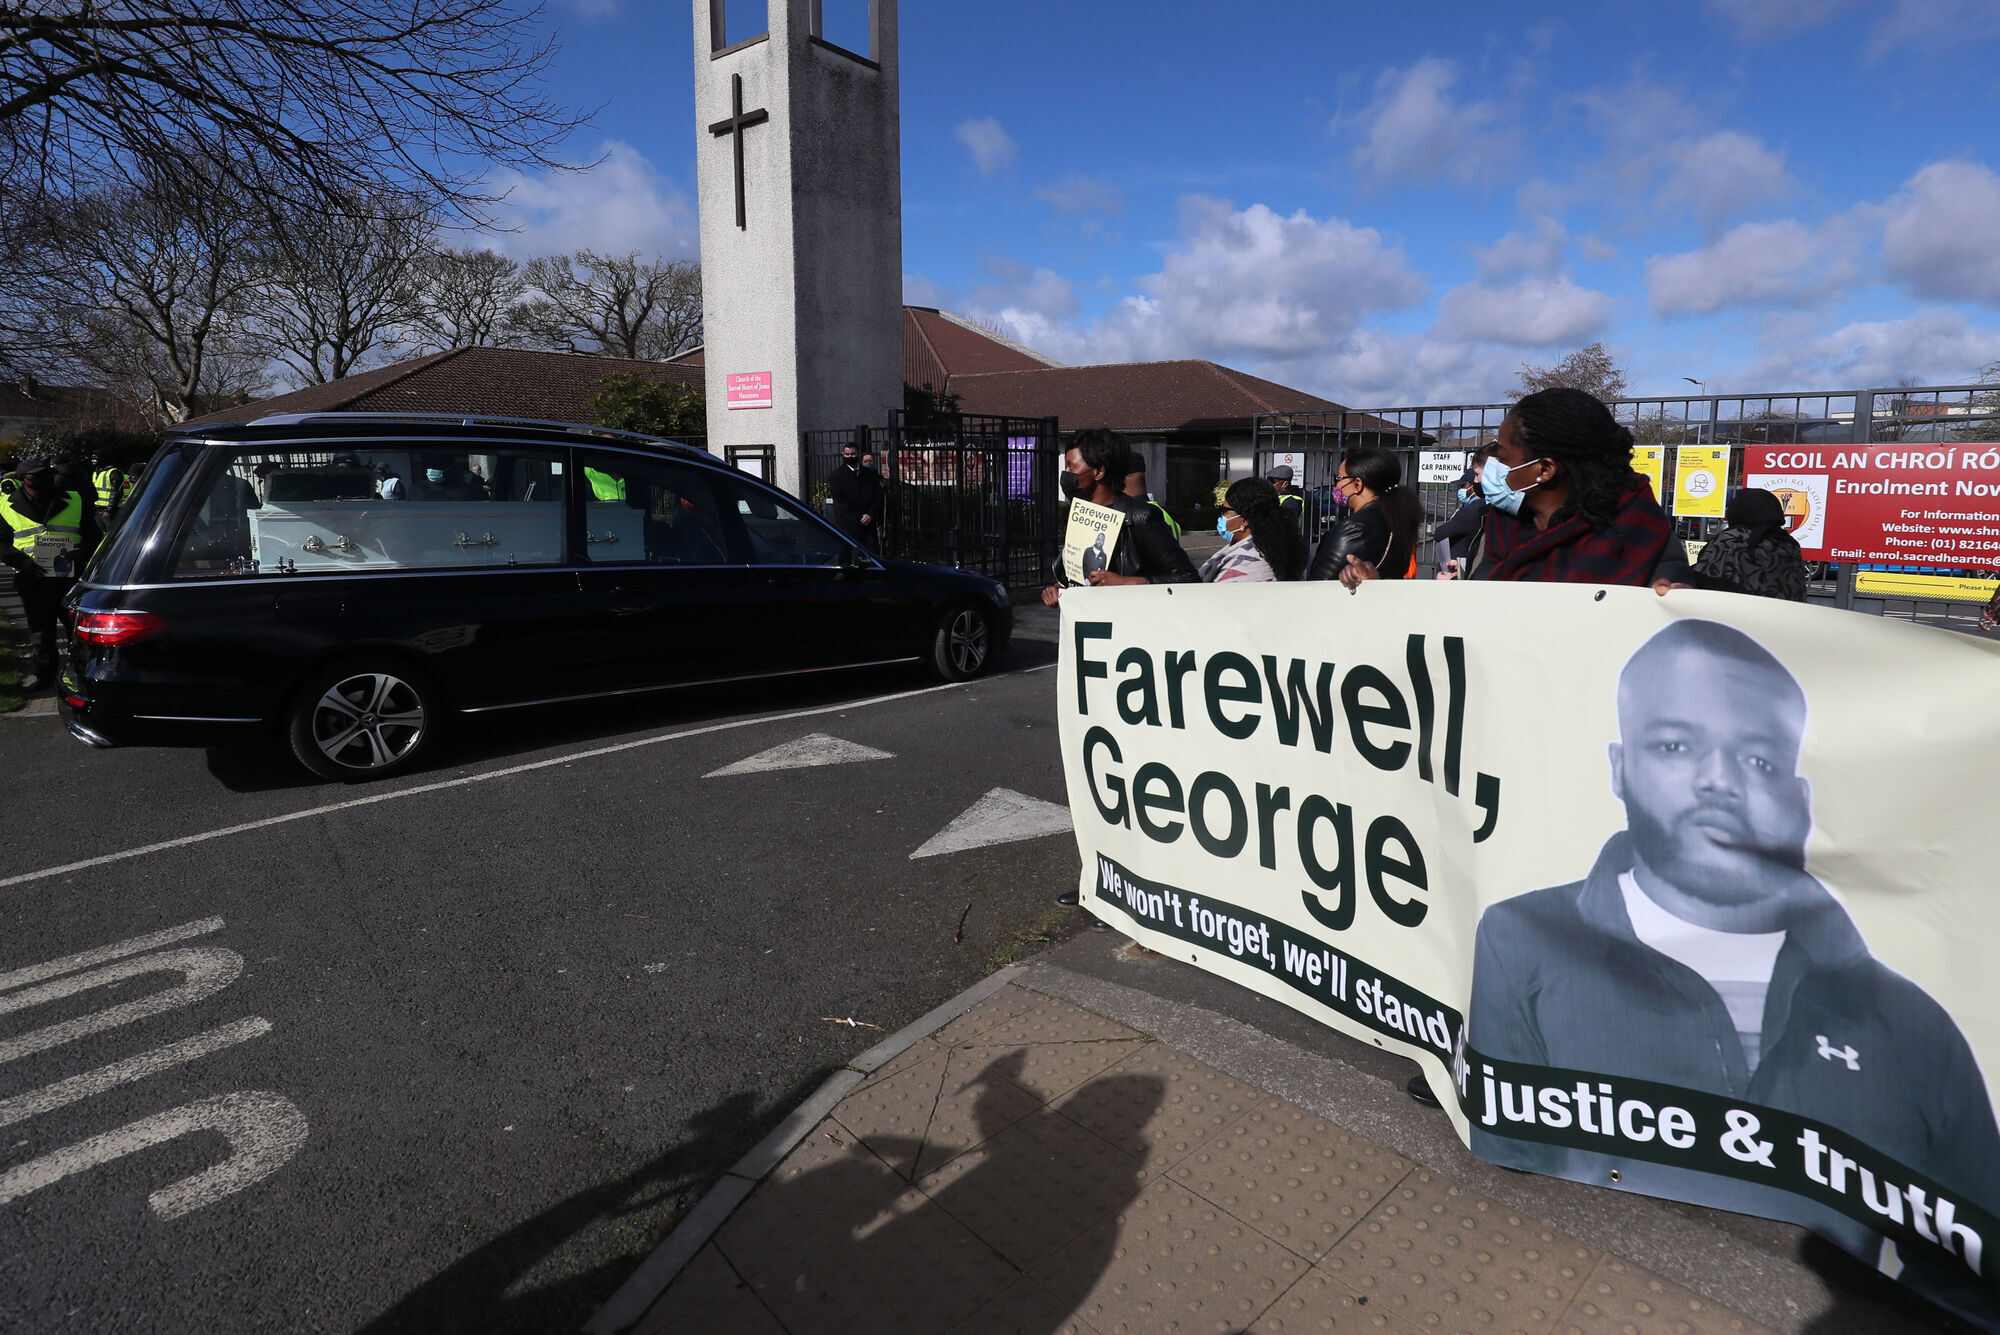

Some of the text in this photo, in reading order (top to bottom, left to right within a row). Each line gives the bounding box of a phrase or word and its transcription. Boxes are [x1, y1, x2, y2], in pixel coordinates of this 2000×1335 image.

[1764, 447, 2000, 470] SCOIL AN CHROÍ RÓ
[1761, 478, 1787, 488] HROI
[1835, 478, 1949, 496] Enrolment
[1071, 512, 1108, 532] George
[1073, 502, 1119, 526] Farewell,
[1900, 510, 2000, 520] For Information
[1882, 523, 1935, 534] Website:
[1830, 548, 1866, 558] Email:
[1885, 537, 2000, 550] Phone: (01) 82164
[1074, 621, 1500, 844] Farewell,
[1083, 725, 1429, 931] George
[1099, 857, 1122, 899] We
[1124, 877, 1184, 929] won't
[1188, 896, 1277, 970] forget,
[1282, 939, 1347, 1002] we'll
[1355, 977, 1454, 1054] stand
[1481, 1064, 1697, 1149] justice
[1719, 1109, 1777, 1169] &
[1796, 1128, 1983, 1278] truth
